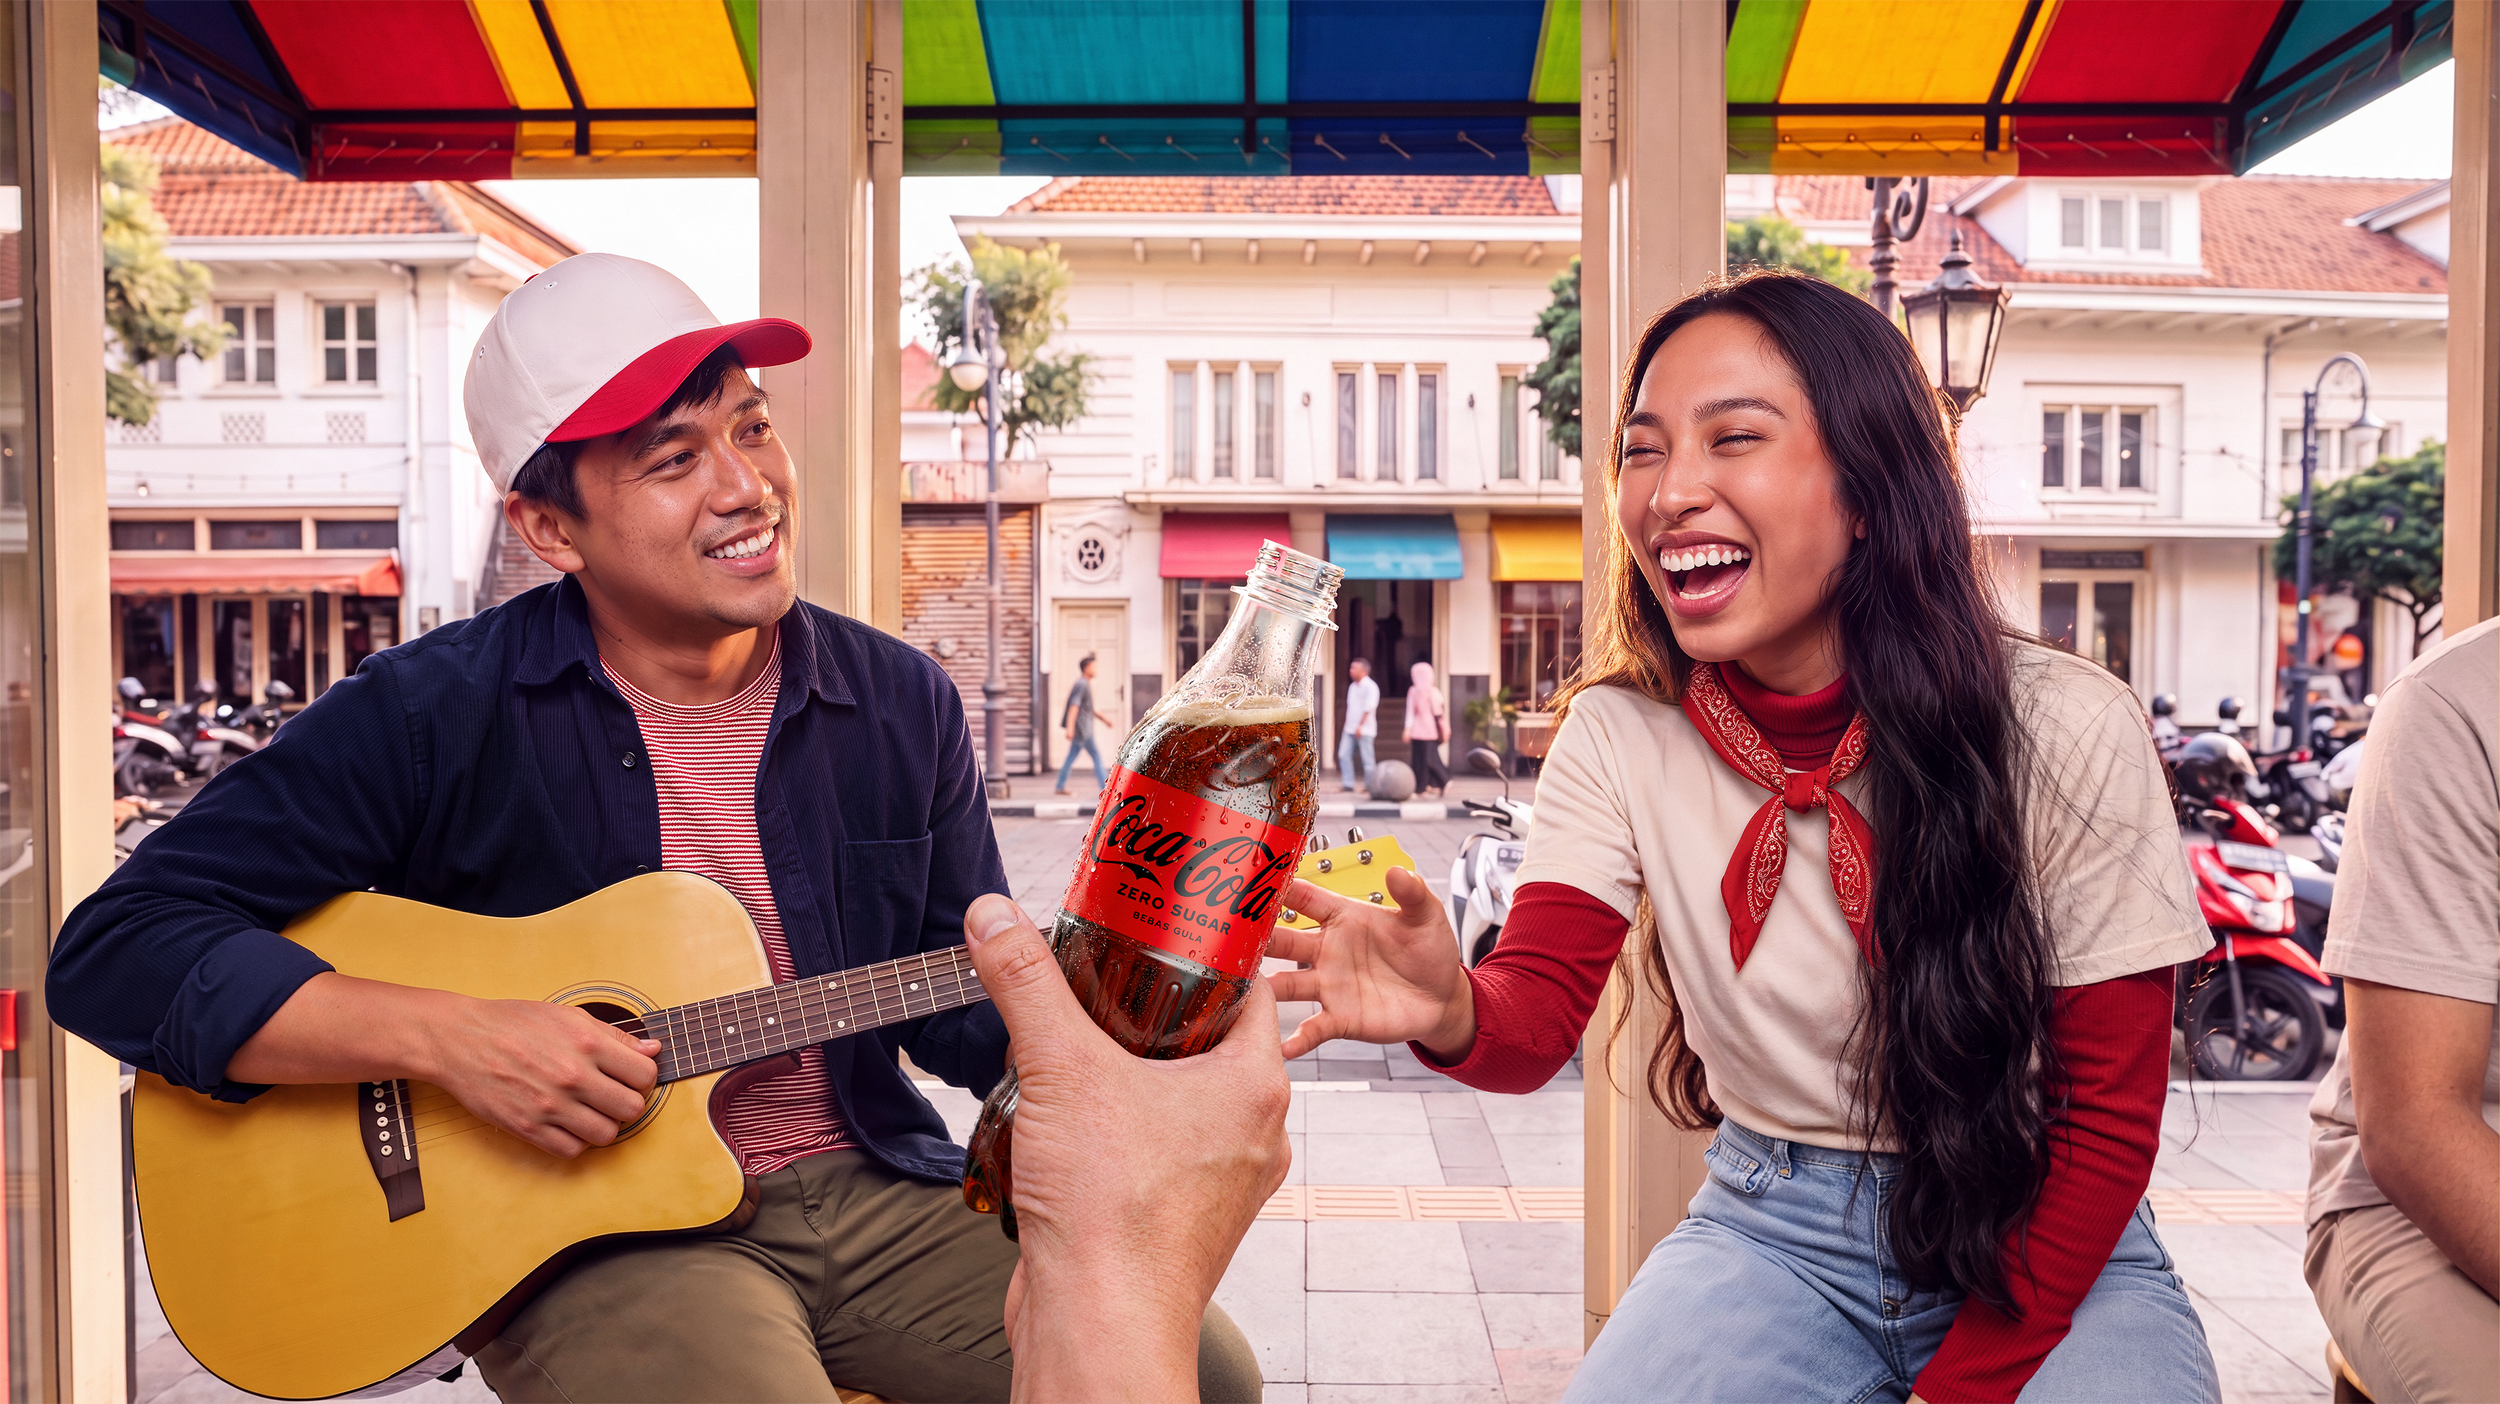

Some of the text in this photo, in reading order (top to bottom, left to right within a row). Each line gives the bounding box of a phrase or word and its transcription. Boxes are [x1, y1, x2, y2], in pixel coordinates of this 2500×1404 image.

[1116, 882, 1231, 936] ZERO SUGAR
[1132, 911, 1202, 943] BEBAS GULA
